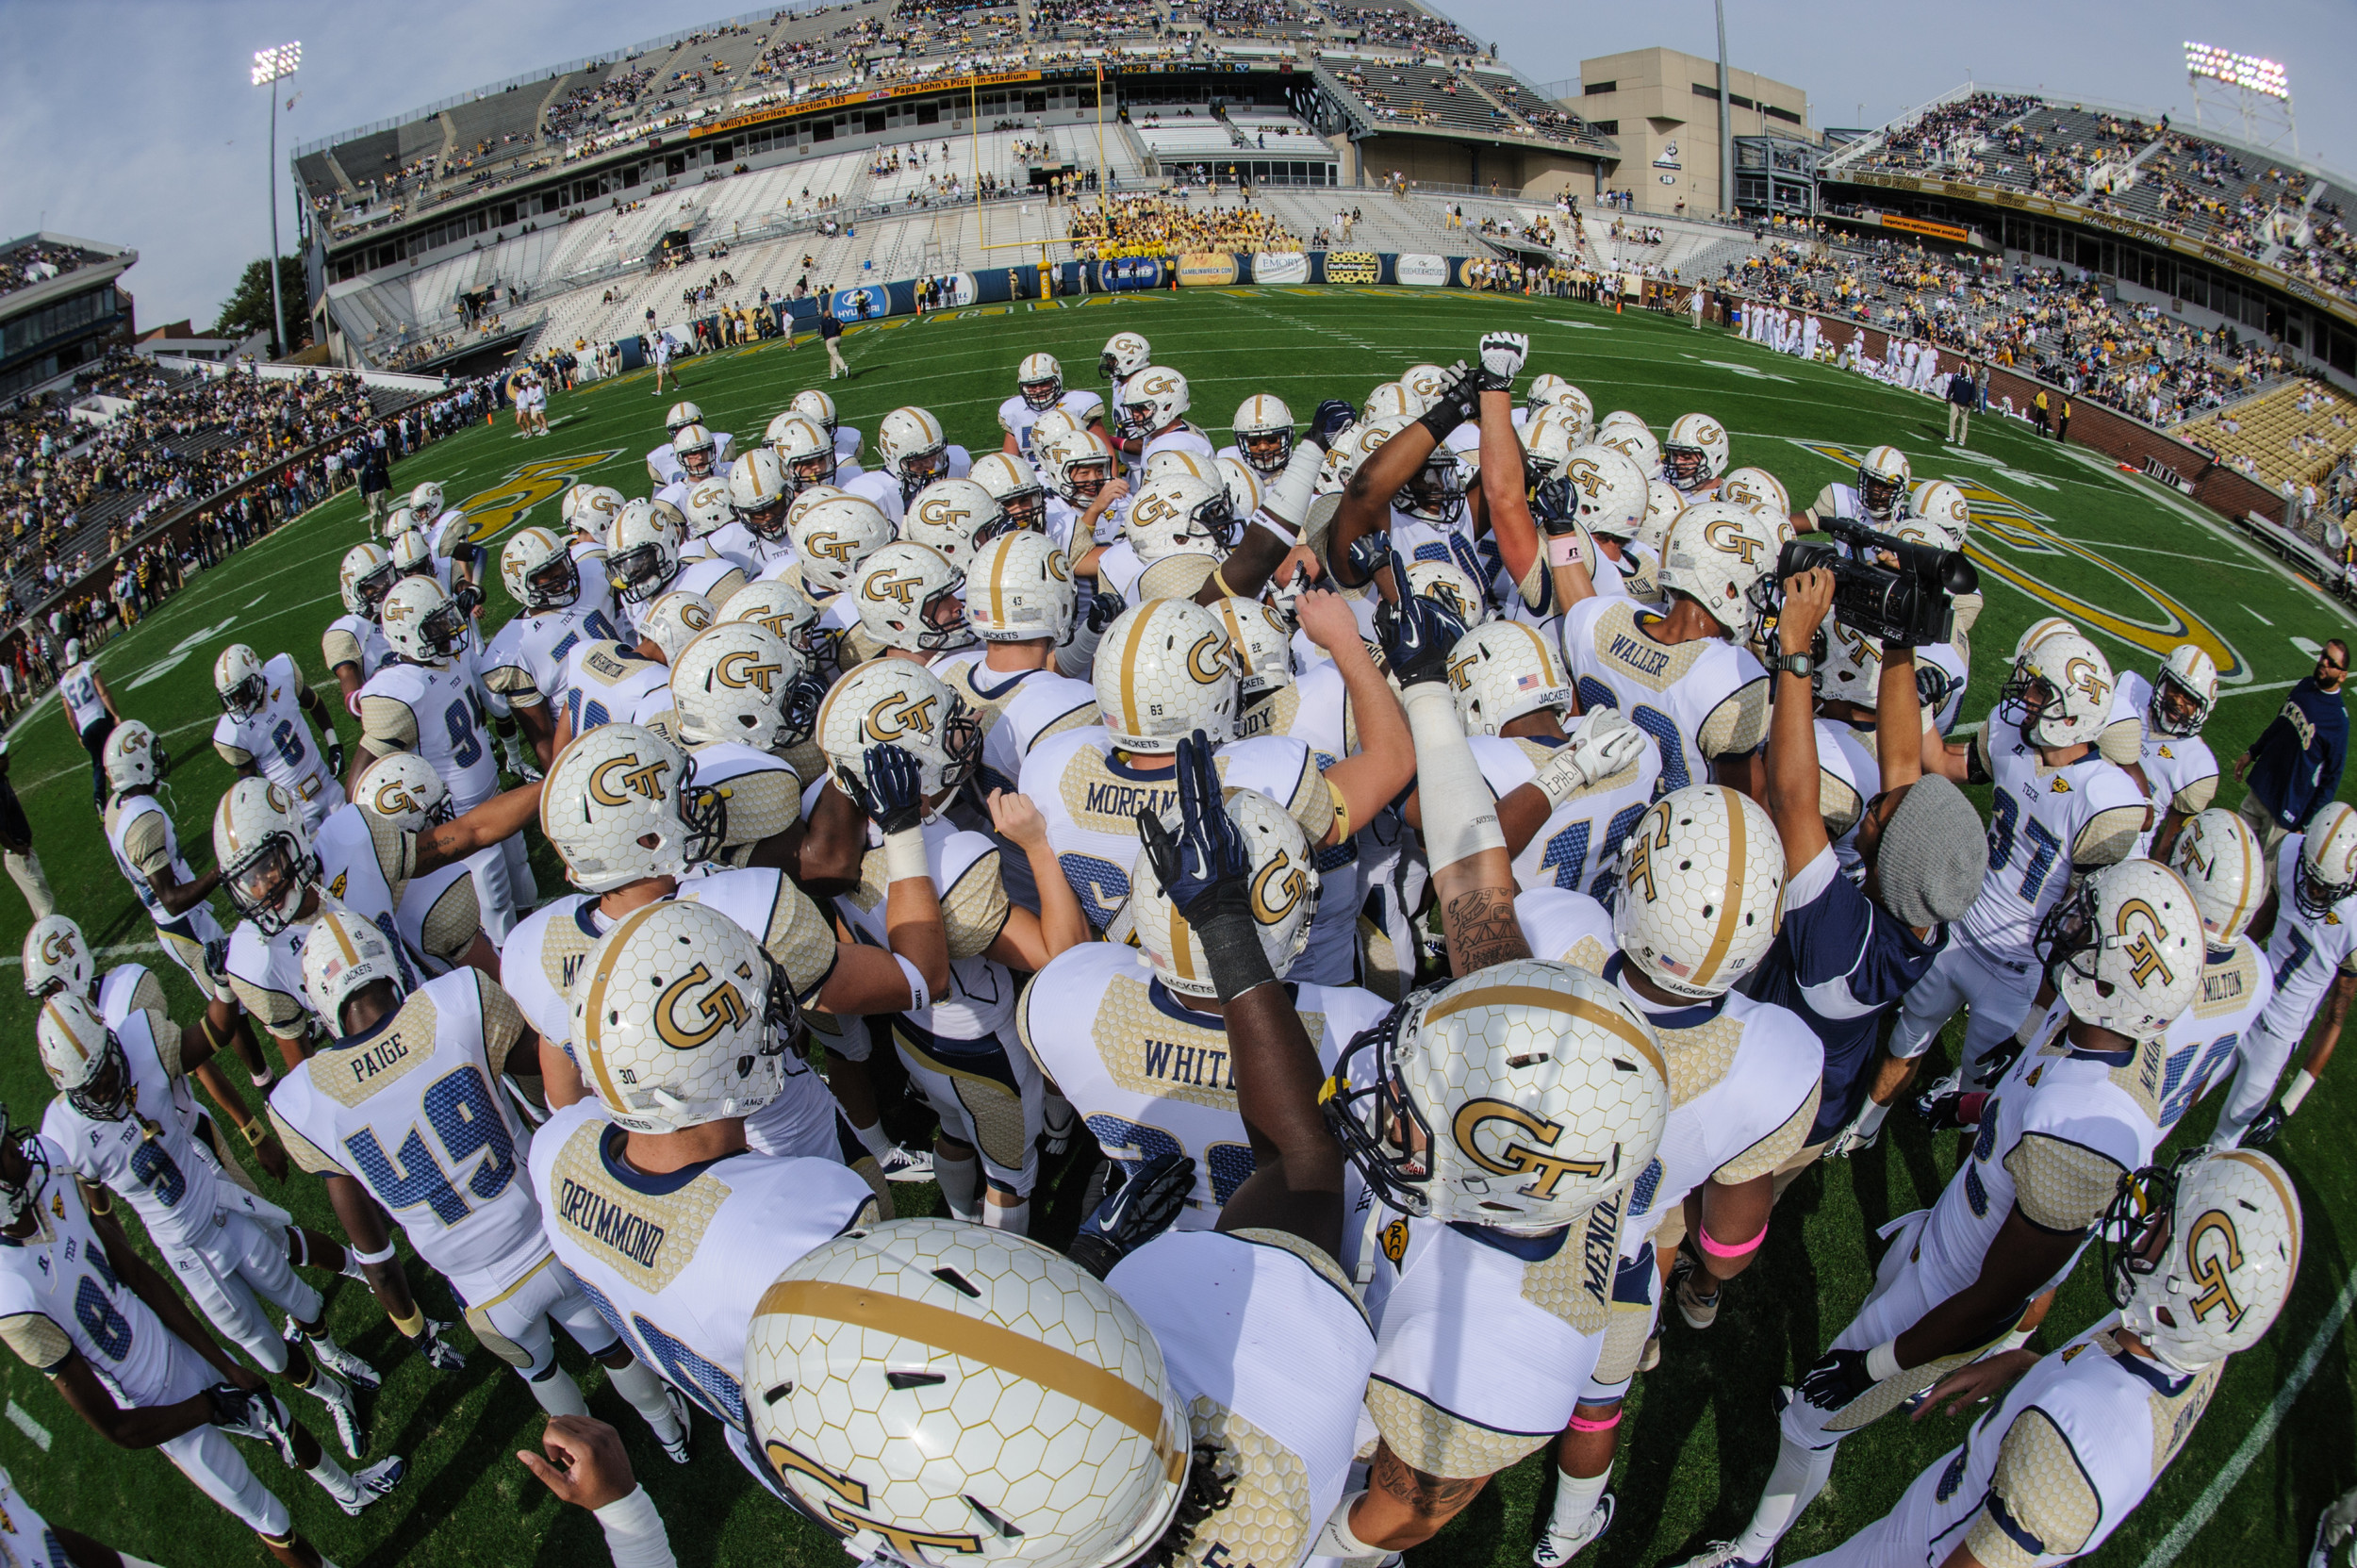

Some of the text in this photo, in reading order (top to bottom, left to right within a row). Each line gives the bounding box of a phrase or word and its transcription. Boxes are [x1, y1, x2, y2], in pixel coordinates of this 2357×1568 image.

[1122, 65, 1147, 74] 24:22
[894, 84, 916, 95] Papa
[918, 80, 948, 92] John's
[977, 72, 1029, 83] in-stadium
[719, 114, 750, 129] Willy's
[750, 108, 787, 124] burritos
[795, 101, 827, 113] section
[830, 97, 846, 106] 103
[1877, 177, 1891, 187] OF
[1892, 179, 1920, 190] FAME
[1911, 223, 1930, 233] options
[1941, 229, 1967, 239] available
[2083, 215, 2172, 248] HALL OF FAME
[1181, 267, 1233, 275] RAMBLINWRECK.COM
[1263, 258, 1300, 267] EMORY
[2286, 283, 2331, 309] MORRIS
[1115, 338, 1141, 355] GT
[1143, 376, 1177, 396] GT
[1559, 393, 1590, 418] GT
[1013, 483, 1025, 492] ACC
[1567, 458, 1615, 499] GT
[590, 494, 623, 517] GT
[693, 487, 725, 509] GT
[1132, 490, 1183, 528] GT
[919, 499, 971, 532] GT
[771, 549, 791, 561] TECH
[807, 532, 860, 563] GT
[1705, 520, 1765, 566] GT
[864, 568, 924, 605] GT
[383, 598, 415, 622] GT
[1013, 596, 1023, 607] 43
[560, 610, 577, 627] TECH
[981, 630, 1019, 642] JACKETS
[1251, 642, 1263, 654] 22
[585, 651, 629, 679] WASHINGTON
[1607, 633, 1671, 678] WALLER
[449, 674, 463, 690] TECH
[717, 651, 783, 695] GT
[2065, 656, 2111, 706] GT
[65, 680, 93, 711] 52
[1538, 686, 1572, 706] JACKETS
[865, 690, 937, 741] GT
[1150, 703, 1163, 717] 63
[1118, 736, 1161, 750] JACKETS
[588, 751, 671, 807] GT
[2052, 778, 2069, 792] ACC
[2021, 781, 2040, 804] TECH
[1627, 801, 1673, 905] GT
[332, 875, 347, 896] ACC
[41, 930, 77, 966] GT
[354, 930, 365, 941] 49
[2117, 898, 2174, 990] GT
[1729, 957, 1746, 970] 10
[2274, 921, 2314, 993] 7
[341, 963, 373, 987] JACKETS
[1163, 976, 1216, 995] JACKETS
[2202, 969, 2243, 1003] MILTON
[1669, 981, 1718, 999] JACKETS
[652, 960, 754, 1051] GT
[350, 1032, 409, 1083] PAIGE
[618, 1068, 637, 1085] 30
[119, 1122, 139, 1147] TECH
[340, 1061, 519, 1230] 49
[1451, 1097, 1607, 1202] GT
[559, 1177, 665, 1269] DRUMMOND
[64, 1235, 78, 1264] TECH
[1388, 1223, 1403, 1257] ACC
[2185, 1208, 2246, 1326] GT
